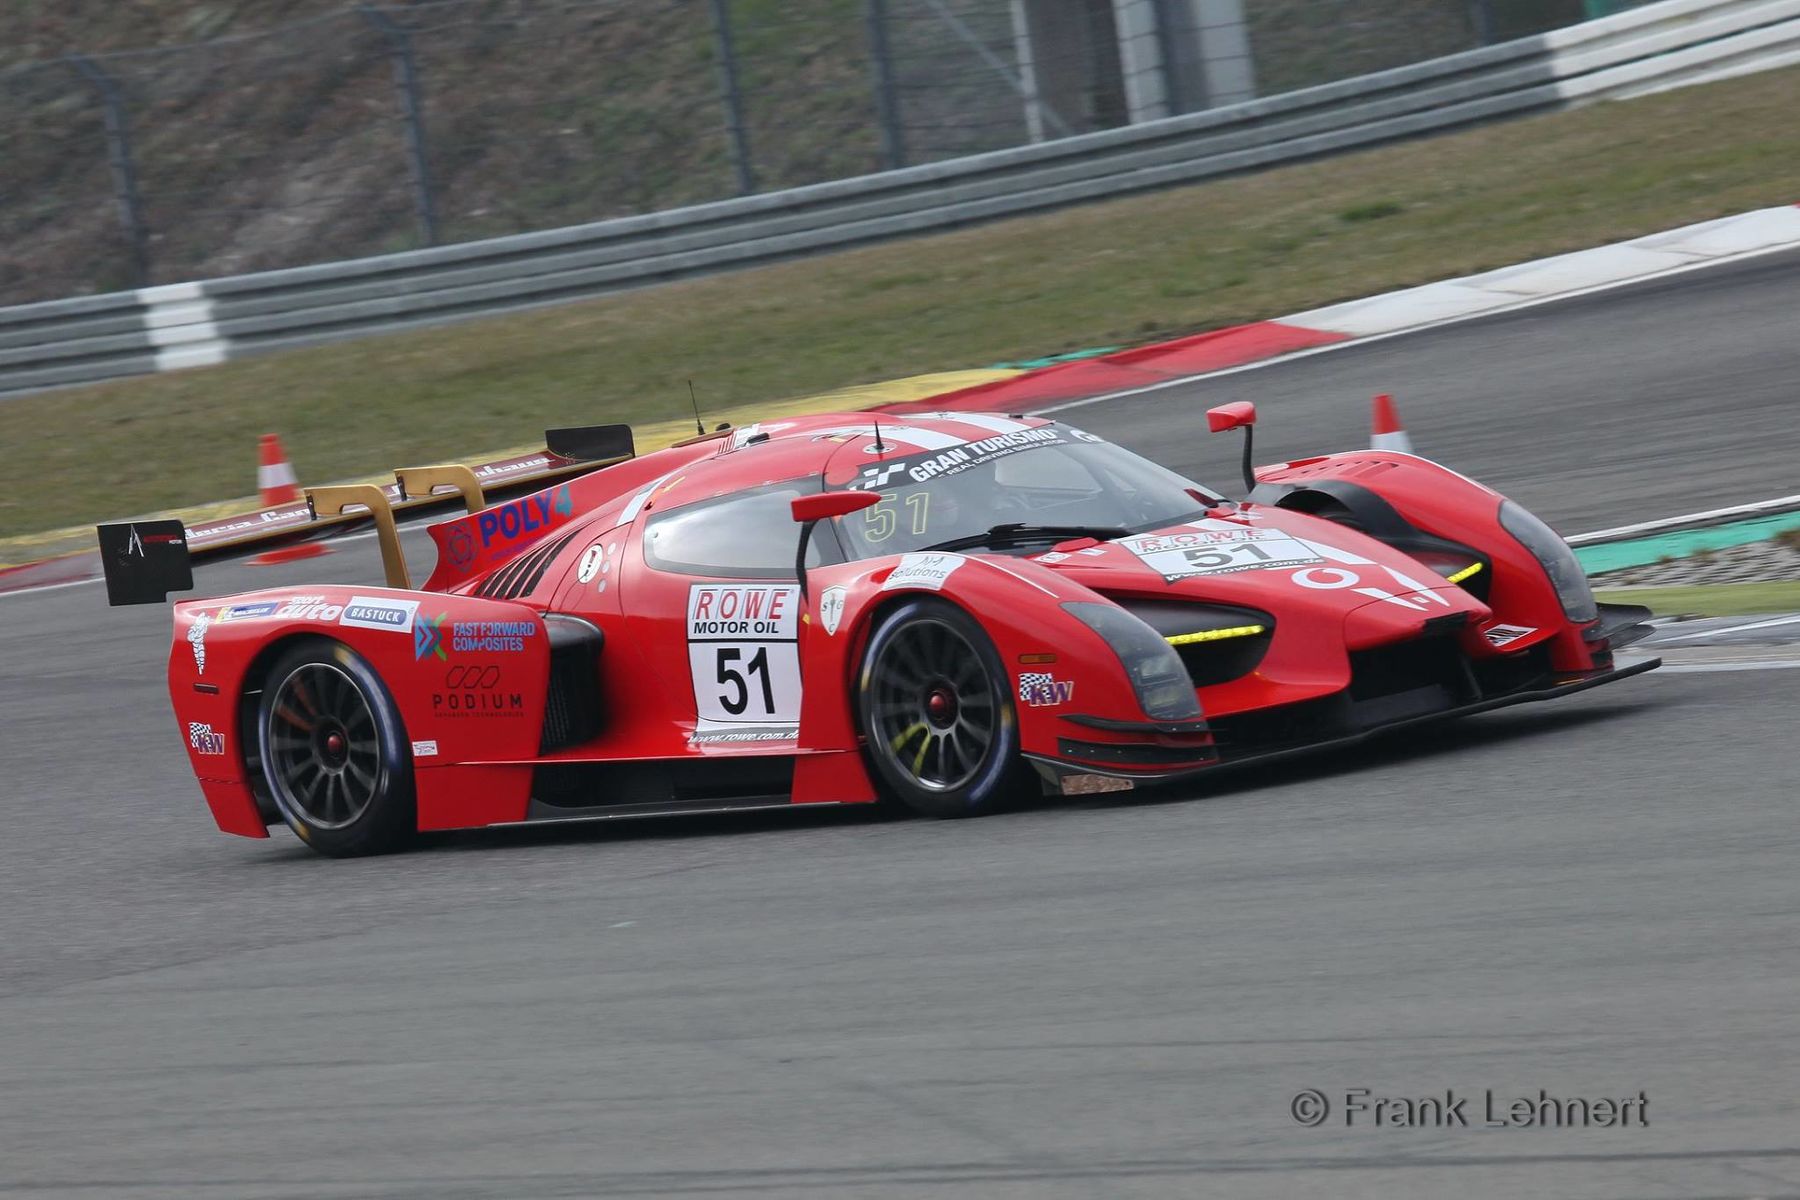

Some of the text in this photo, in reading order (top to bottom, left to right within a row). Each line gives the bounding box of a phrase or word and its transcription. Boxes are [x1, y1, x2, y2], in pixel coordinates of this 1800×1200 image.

[908, 448, 971, 483] GRAN
[964, 430, 1056, 456] TURISMO
[865, 492, 929, 543] 51
[1137, 530, 1265, 549] ROWE
[1182, 543, 1272, 568] 51
[276, 602, 344, 621] auto
[351, 607, 401, 623] BASTUCK
[693, 589, 788, 620] ROWE
[453, 622, 536, 637] FAST FORWARD
[693, 621, 780, 634] MOTOR OIL
[452, 637, 524, 652] COMPOSITES
[716, 646, 776, 716] 51
[432, 694, 523, 709] PODIUM
[1028, 680, 1074, 706] KW
[196, 732, 225, 755] KW
